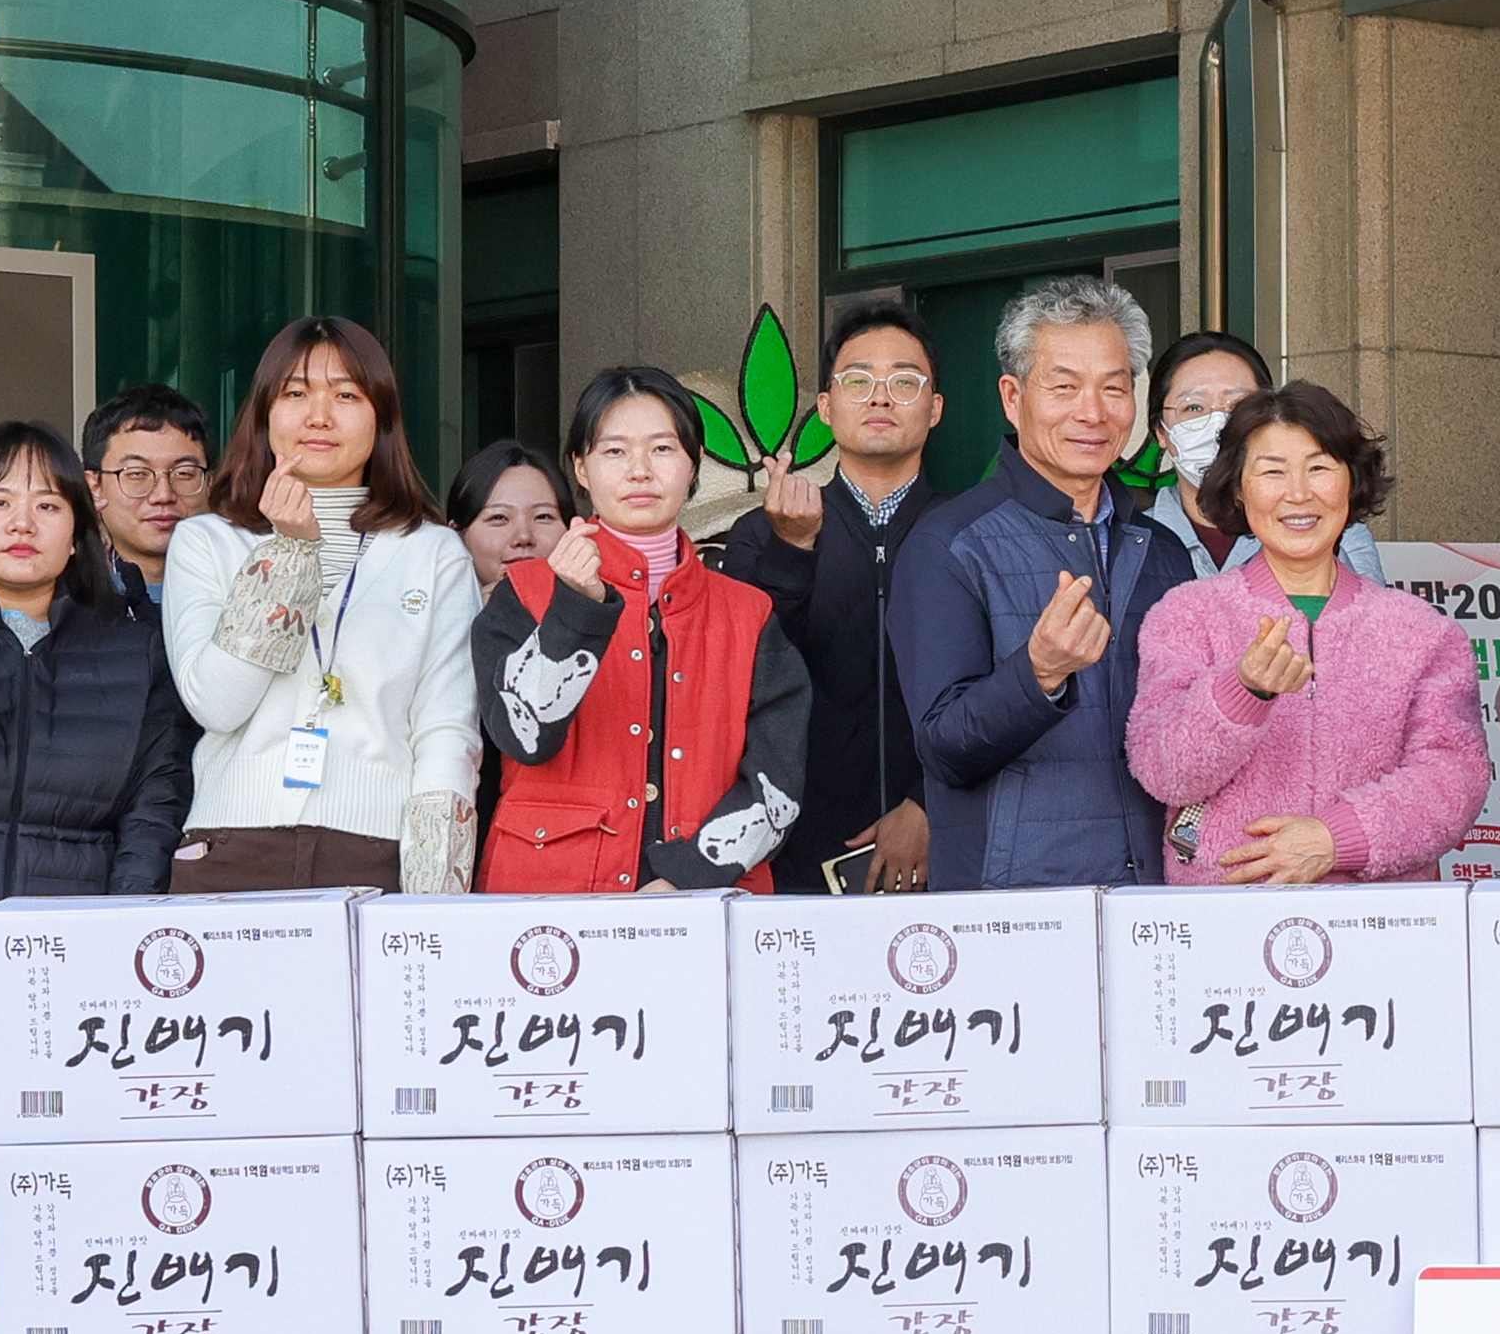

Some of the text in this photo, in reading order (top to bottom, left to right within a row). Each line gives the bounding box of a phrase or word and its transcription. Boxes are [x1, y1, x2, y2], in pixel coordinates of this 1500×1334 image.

[5, 934, 66, 964] (주)가득
[236, 928, 260, 941] 1억원
[382, 931, 442, 960] (주)가득
[755, 928, 816, 958] (주)가득
[1131, 921, 1193, 950] (주)가득
[65, 1010, 271, 1070] 진배기
[440, 1009, 644, 1068] 진배기
[815, 1002, 1021, 1064] 진배기
[1190, 1001, 1398, 1057] 진배기
[126, 1081, 211, 1112] 간장
[499, 1080, 584, 1110] 간장
[876, 1075, 961, 1106] 간장
[1249, 1071, 1335, 1099] 간장
[386, 1163, 446, 1193] (주)가득
[616, 1158, 640, 1171] 1억원
[768, 1159, 828, 1189] (주)가득
[1137, 1152, 1199, 1183] (주)가득
[10, 1171, 72, 1201] (주)가득
[71, 1246, 278, 1307] 진배기
[445, 1240, 649, 1300] 진배기
[826, 1236, 1034, 1297] 진배기
[1194, 1234, 1399, 1291] 진배기
[1253, 1304, 1338, 1332] 간장
